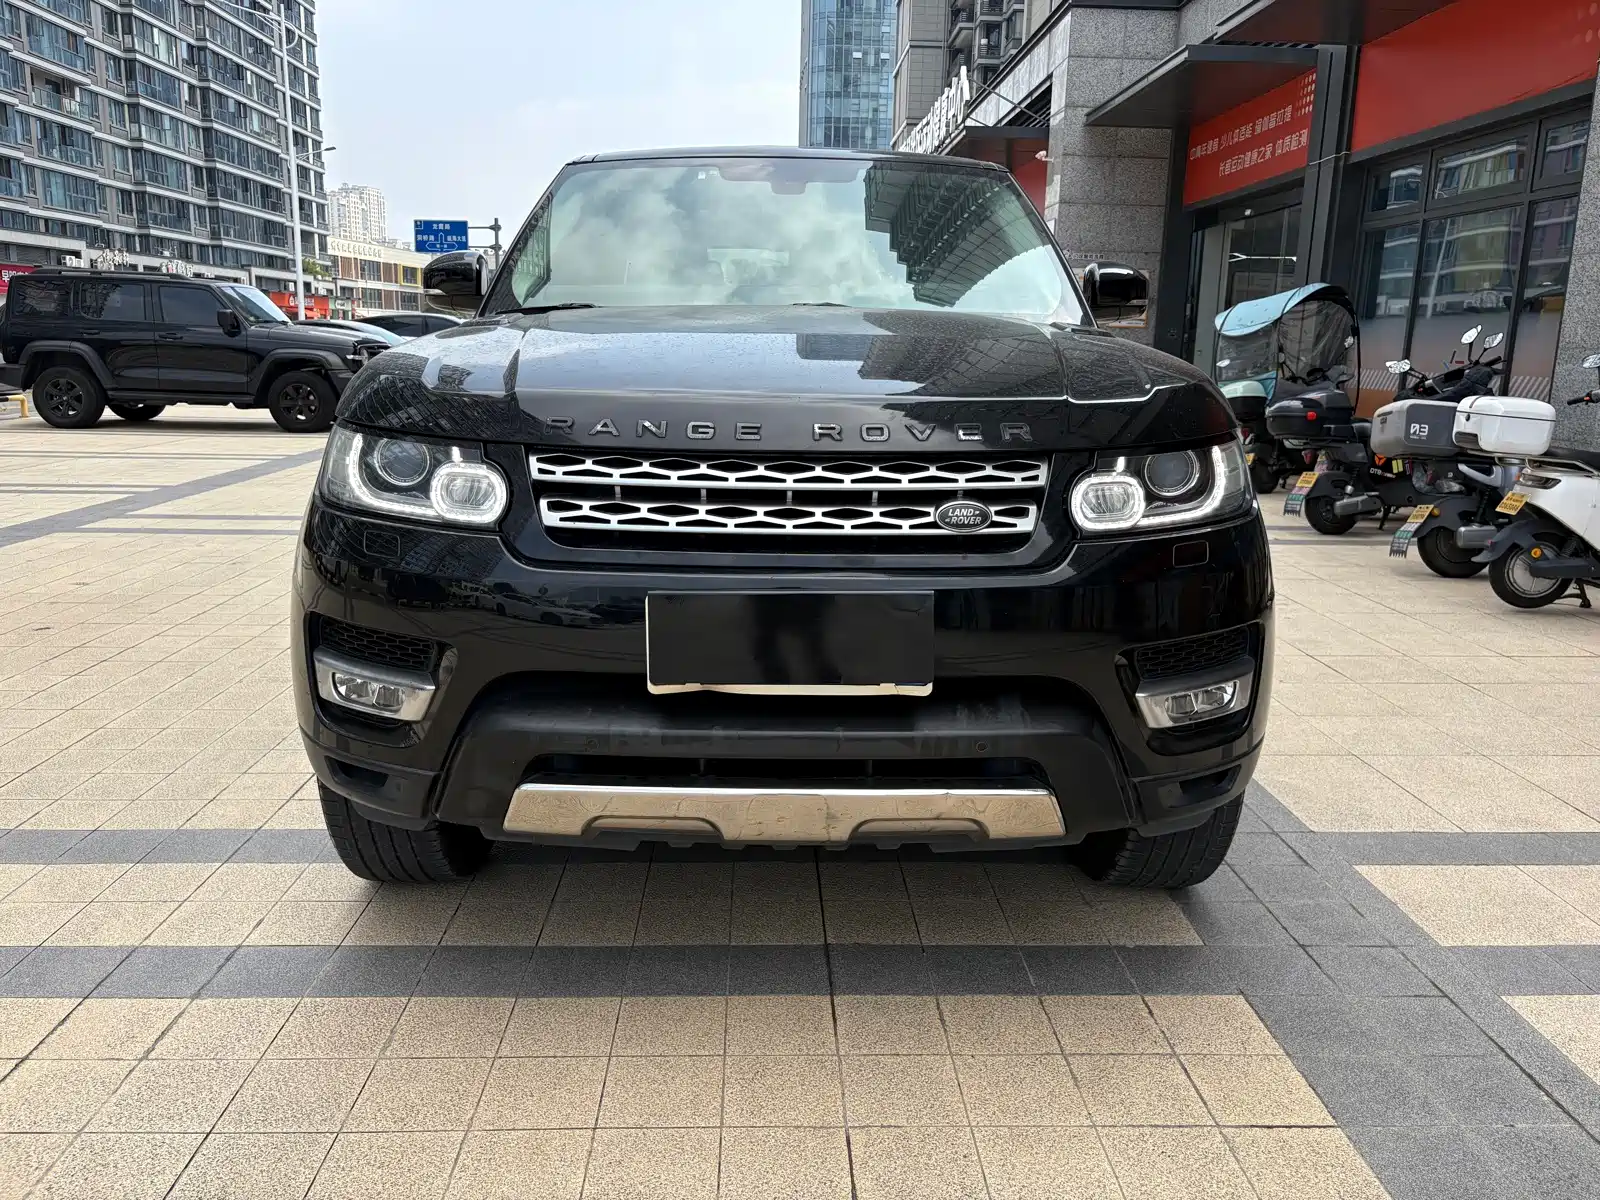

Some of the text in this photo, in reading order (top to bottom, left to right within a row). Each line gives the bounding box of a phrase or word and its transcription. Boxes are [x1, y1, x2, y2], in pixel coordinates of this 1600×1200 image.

[543, 416, 1033, 442] RANGE ROVER
[948, 508, 974, 516] LAND
[950, 516, 982, 524] ROVER
